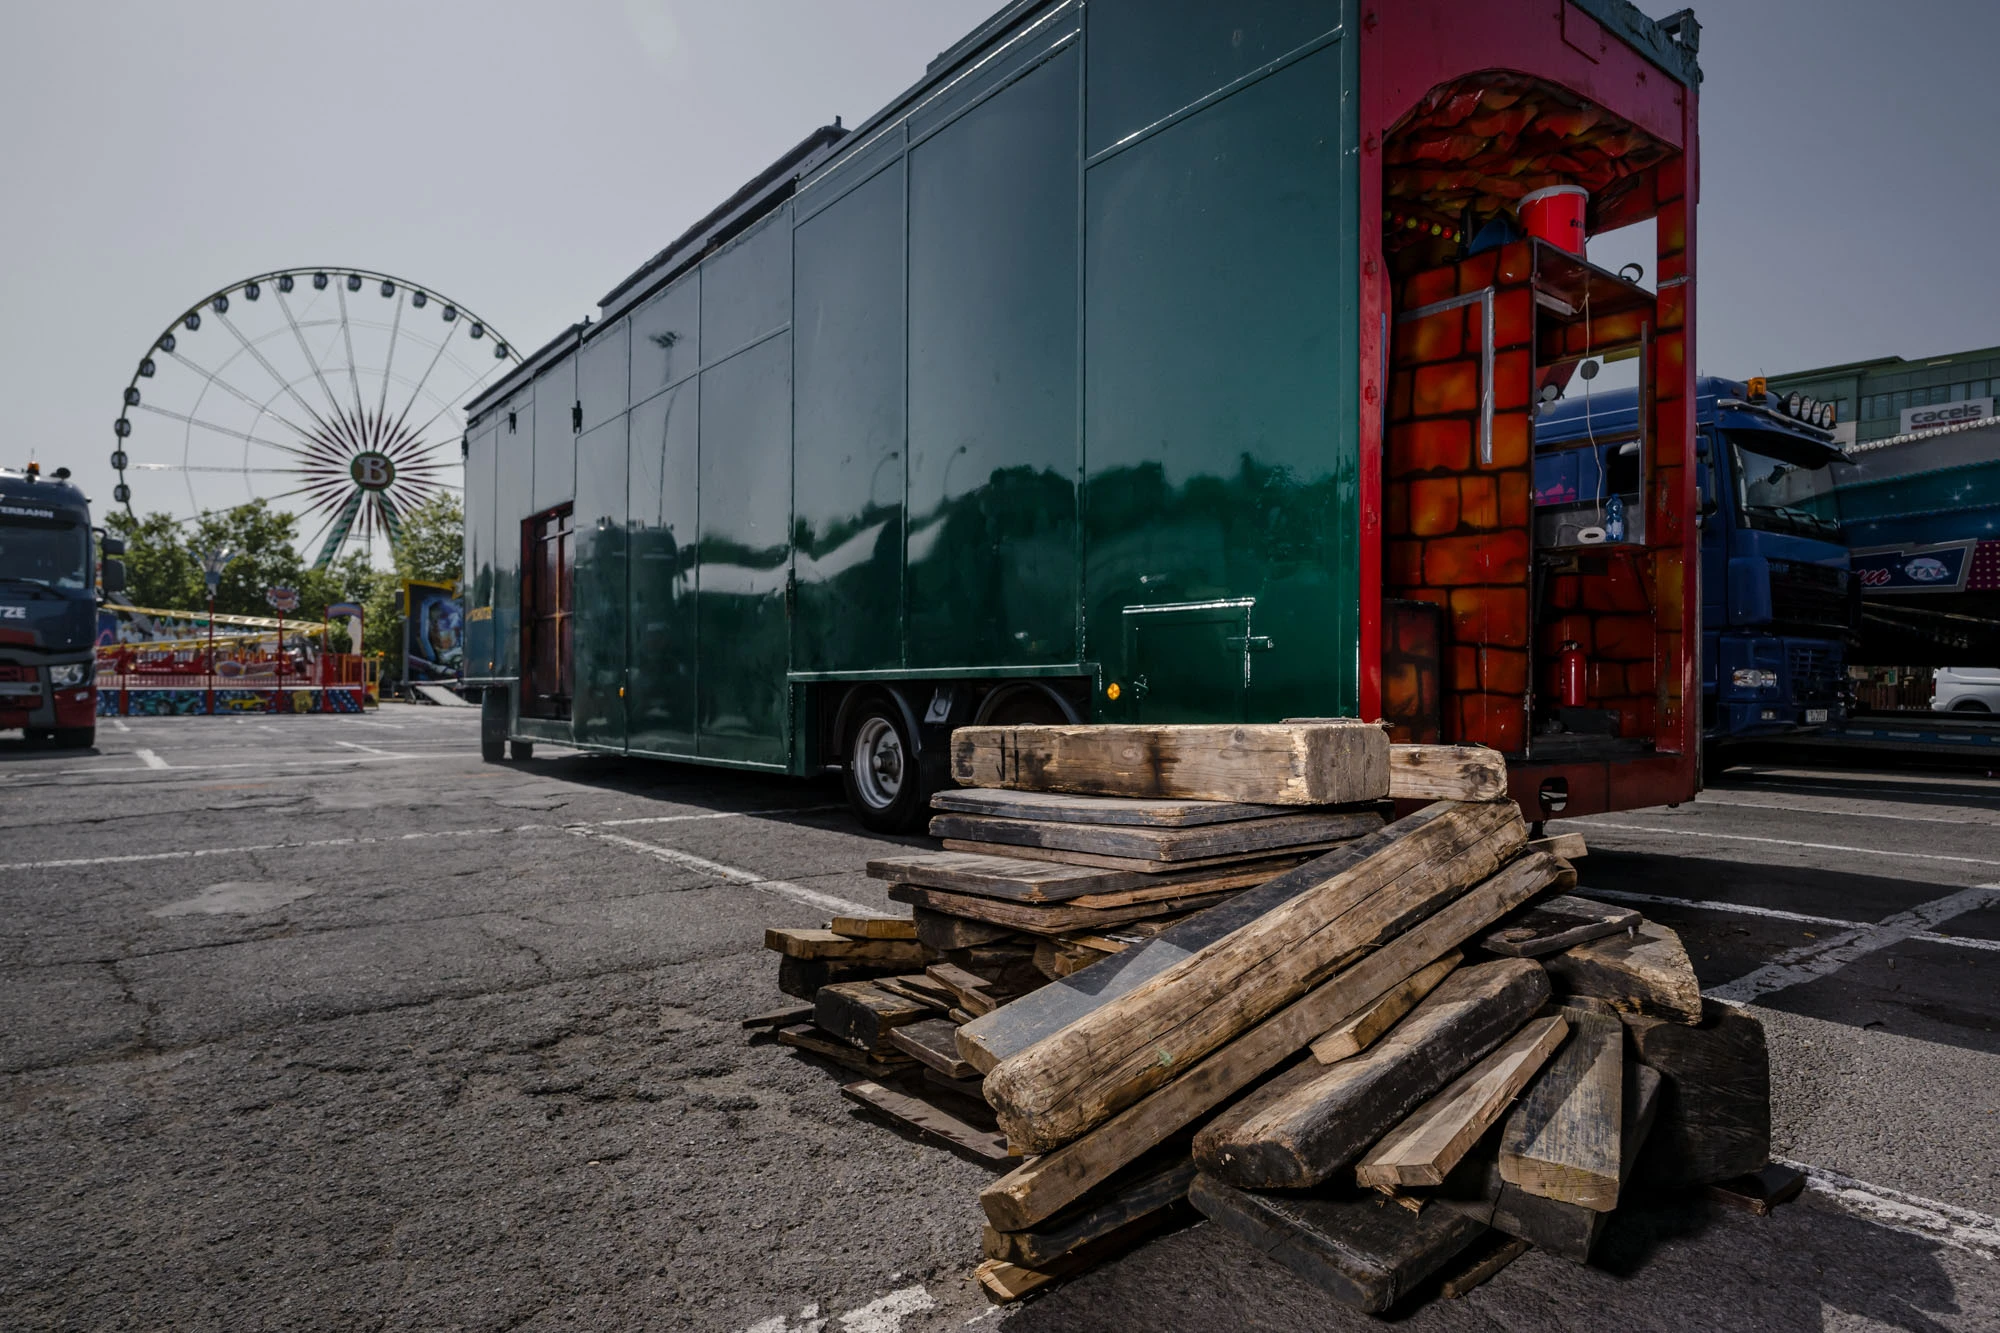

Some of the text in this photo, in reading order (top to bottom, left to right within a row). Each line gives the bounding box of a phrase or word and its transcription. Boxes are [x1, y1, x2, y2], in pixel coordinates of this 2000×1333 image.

[1911, 404, 1982, 424] caceis
[358, 456, 388, 485] B
[0, 505, 54, 519] ERBAHN
